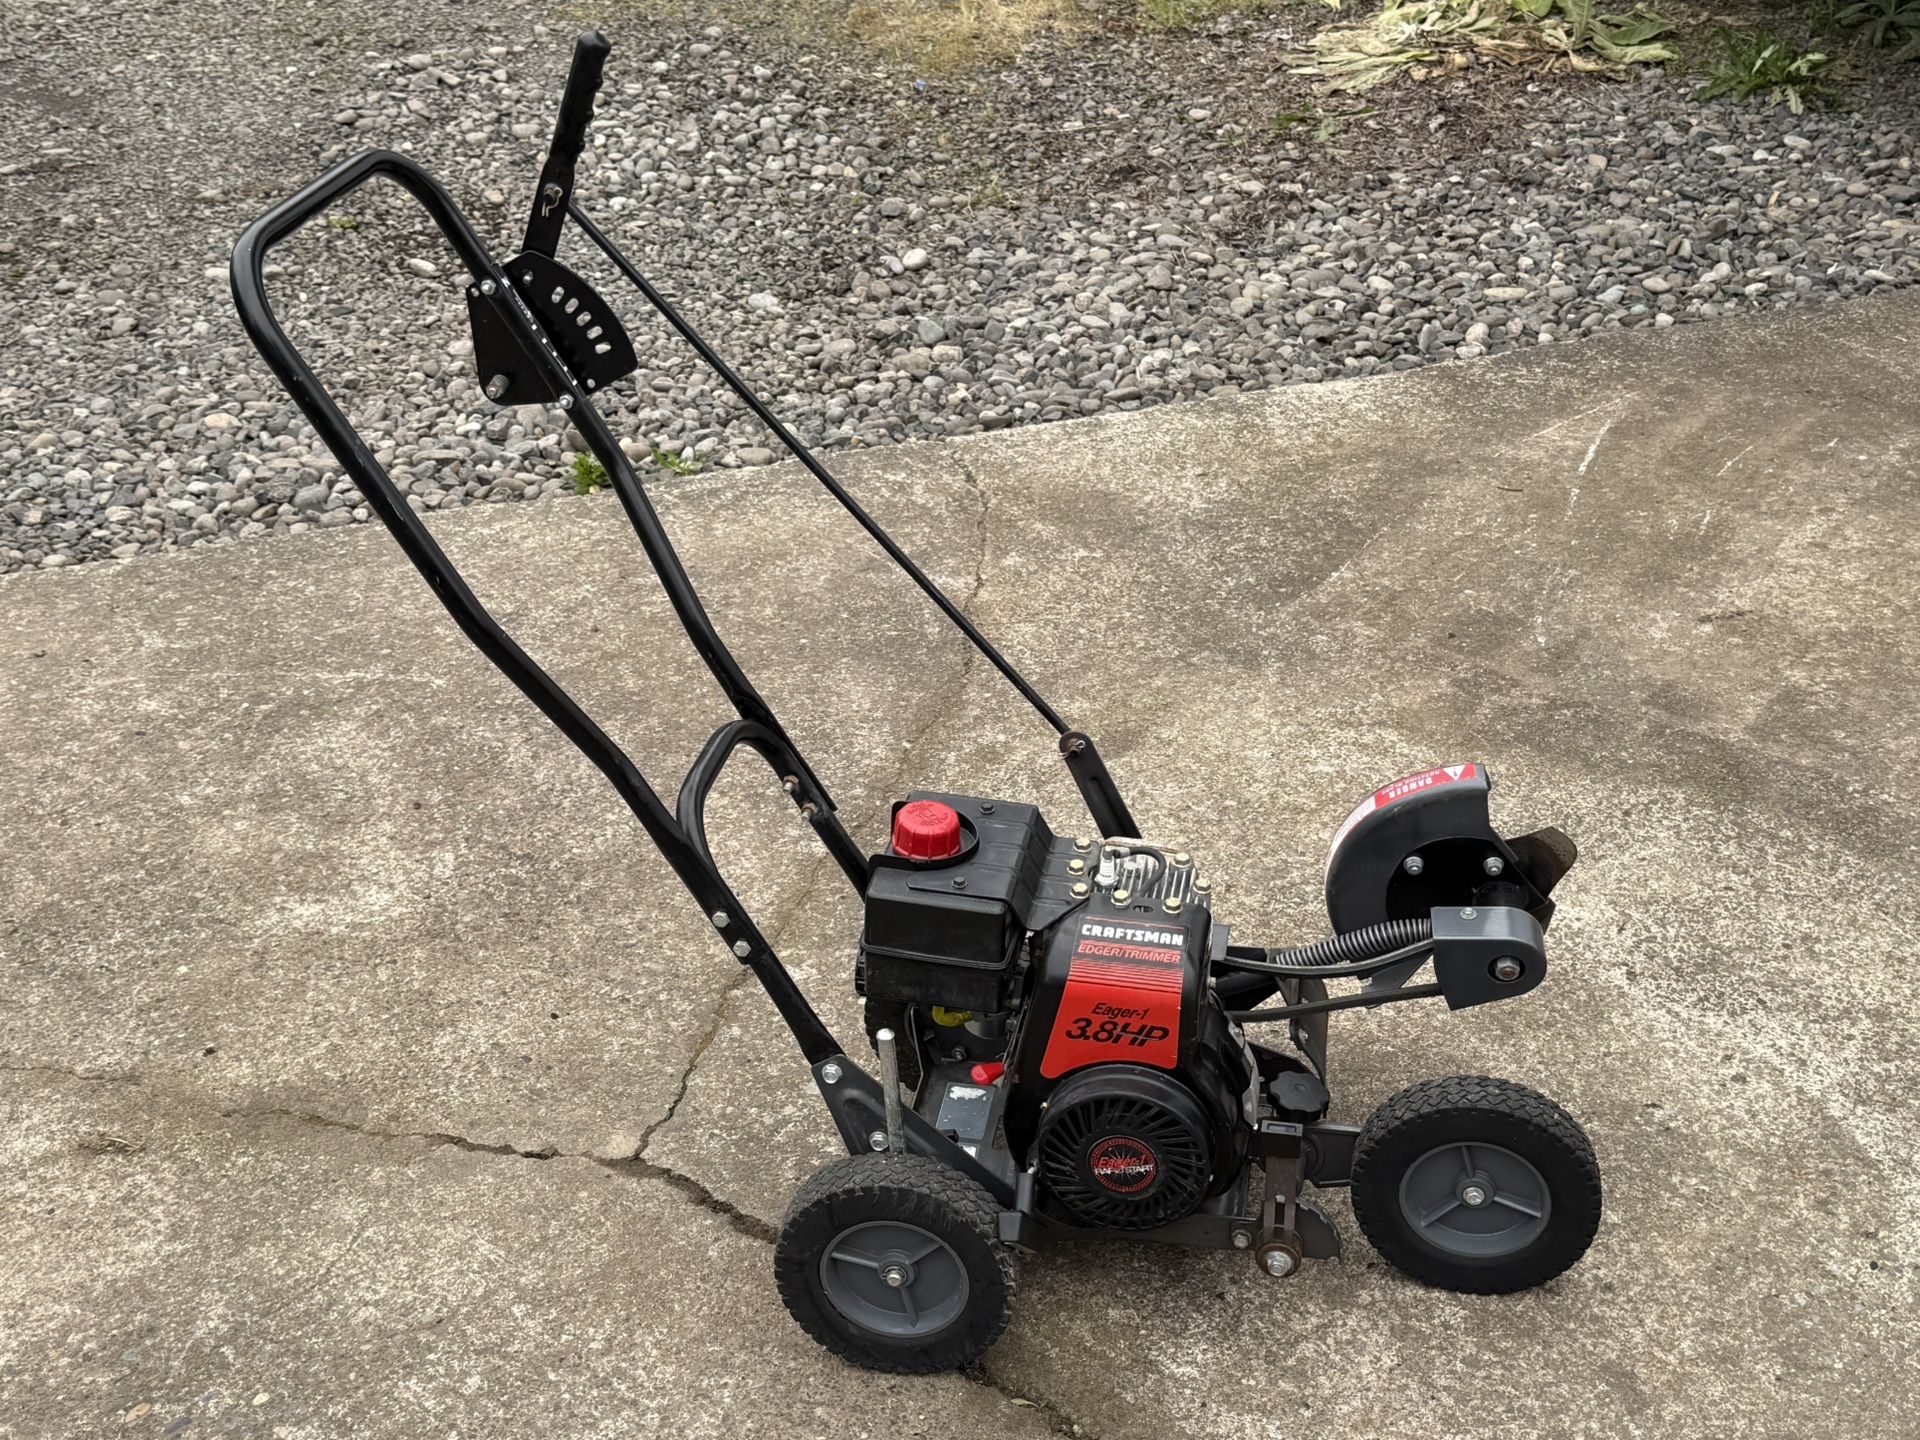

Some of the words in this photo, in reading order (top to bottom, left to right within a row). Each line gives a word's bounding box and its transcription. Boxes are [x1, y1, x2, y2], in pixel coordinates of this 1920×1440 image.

[1388, 776, 1433, 799] DANGER
[1081, 924, 1184, 946] CRAFTSMAN
[1077, 944, 1182, 964] EDGER/TRIMMER
[1091, 1002, 1150, 1020] Eager-1
[1065, 1018, 1170, 1047] 3.8HP
[1125, 1164, 1154, 1175] START
